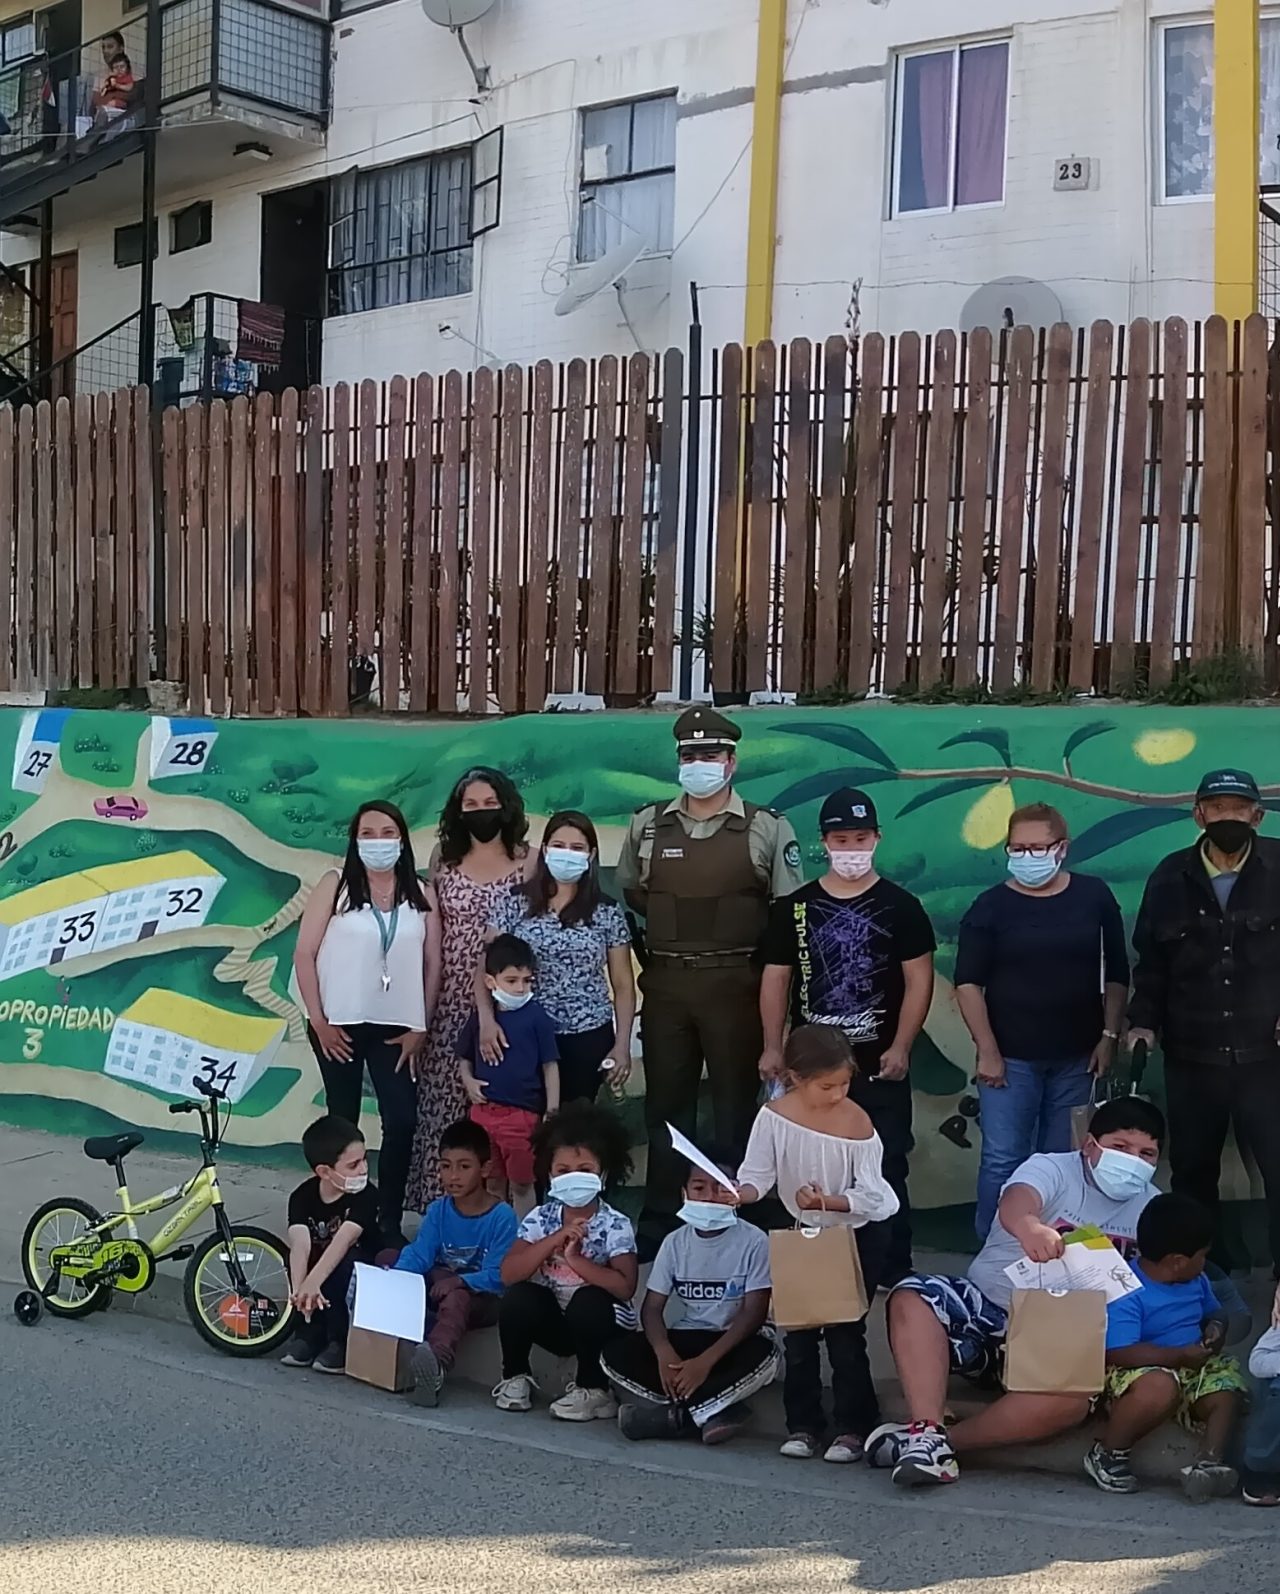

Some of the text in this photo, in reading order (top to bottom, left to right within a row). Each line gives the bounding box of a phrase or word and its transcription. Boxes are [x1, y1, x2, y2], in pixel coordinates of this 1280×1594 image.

[1059, 162, 1082, 181] 23
[23, 750, 52, 777] 27
[169, 740, 208, 766] 28
[166, 887, 204, 917] 32
[59, 910, 97, 945] 33
[793, 901, 813, 1020] ELECTRIC PULSE
[22, 1027, 44, 1060] 3
[200, 1056, 238, 1093] 34
[678, 1282, 725, 1299] adidas
